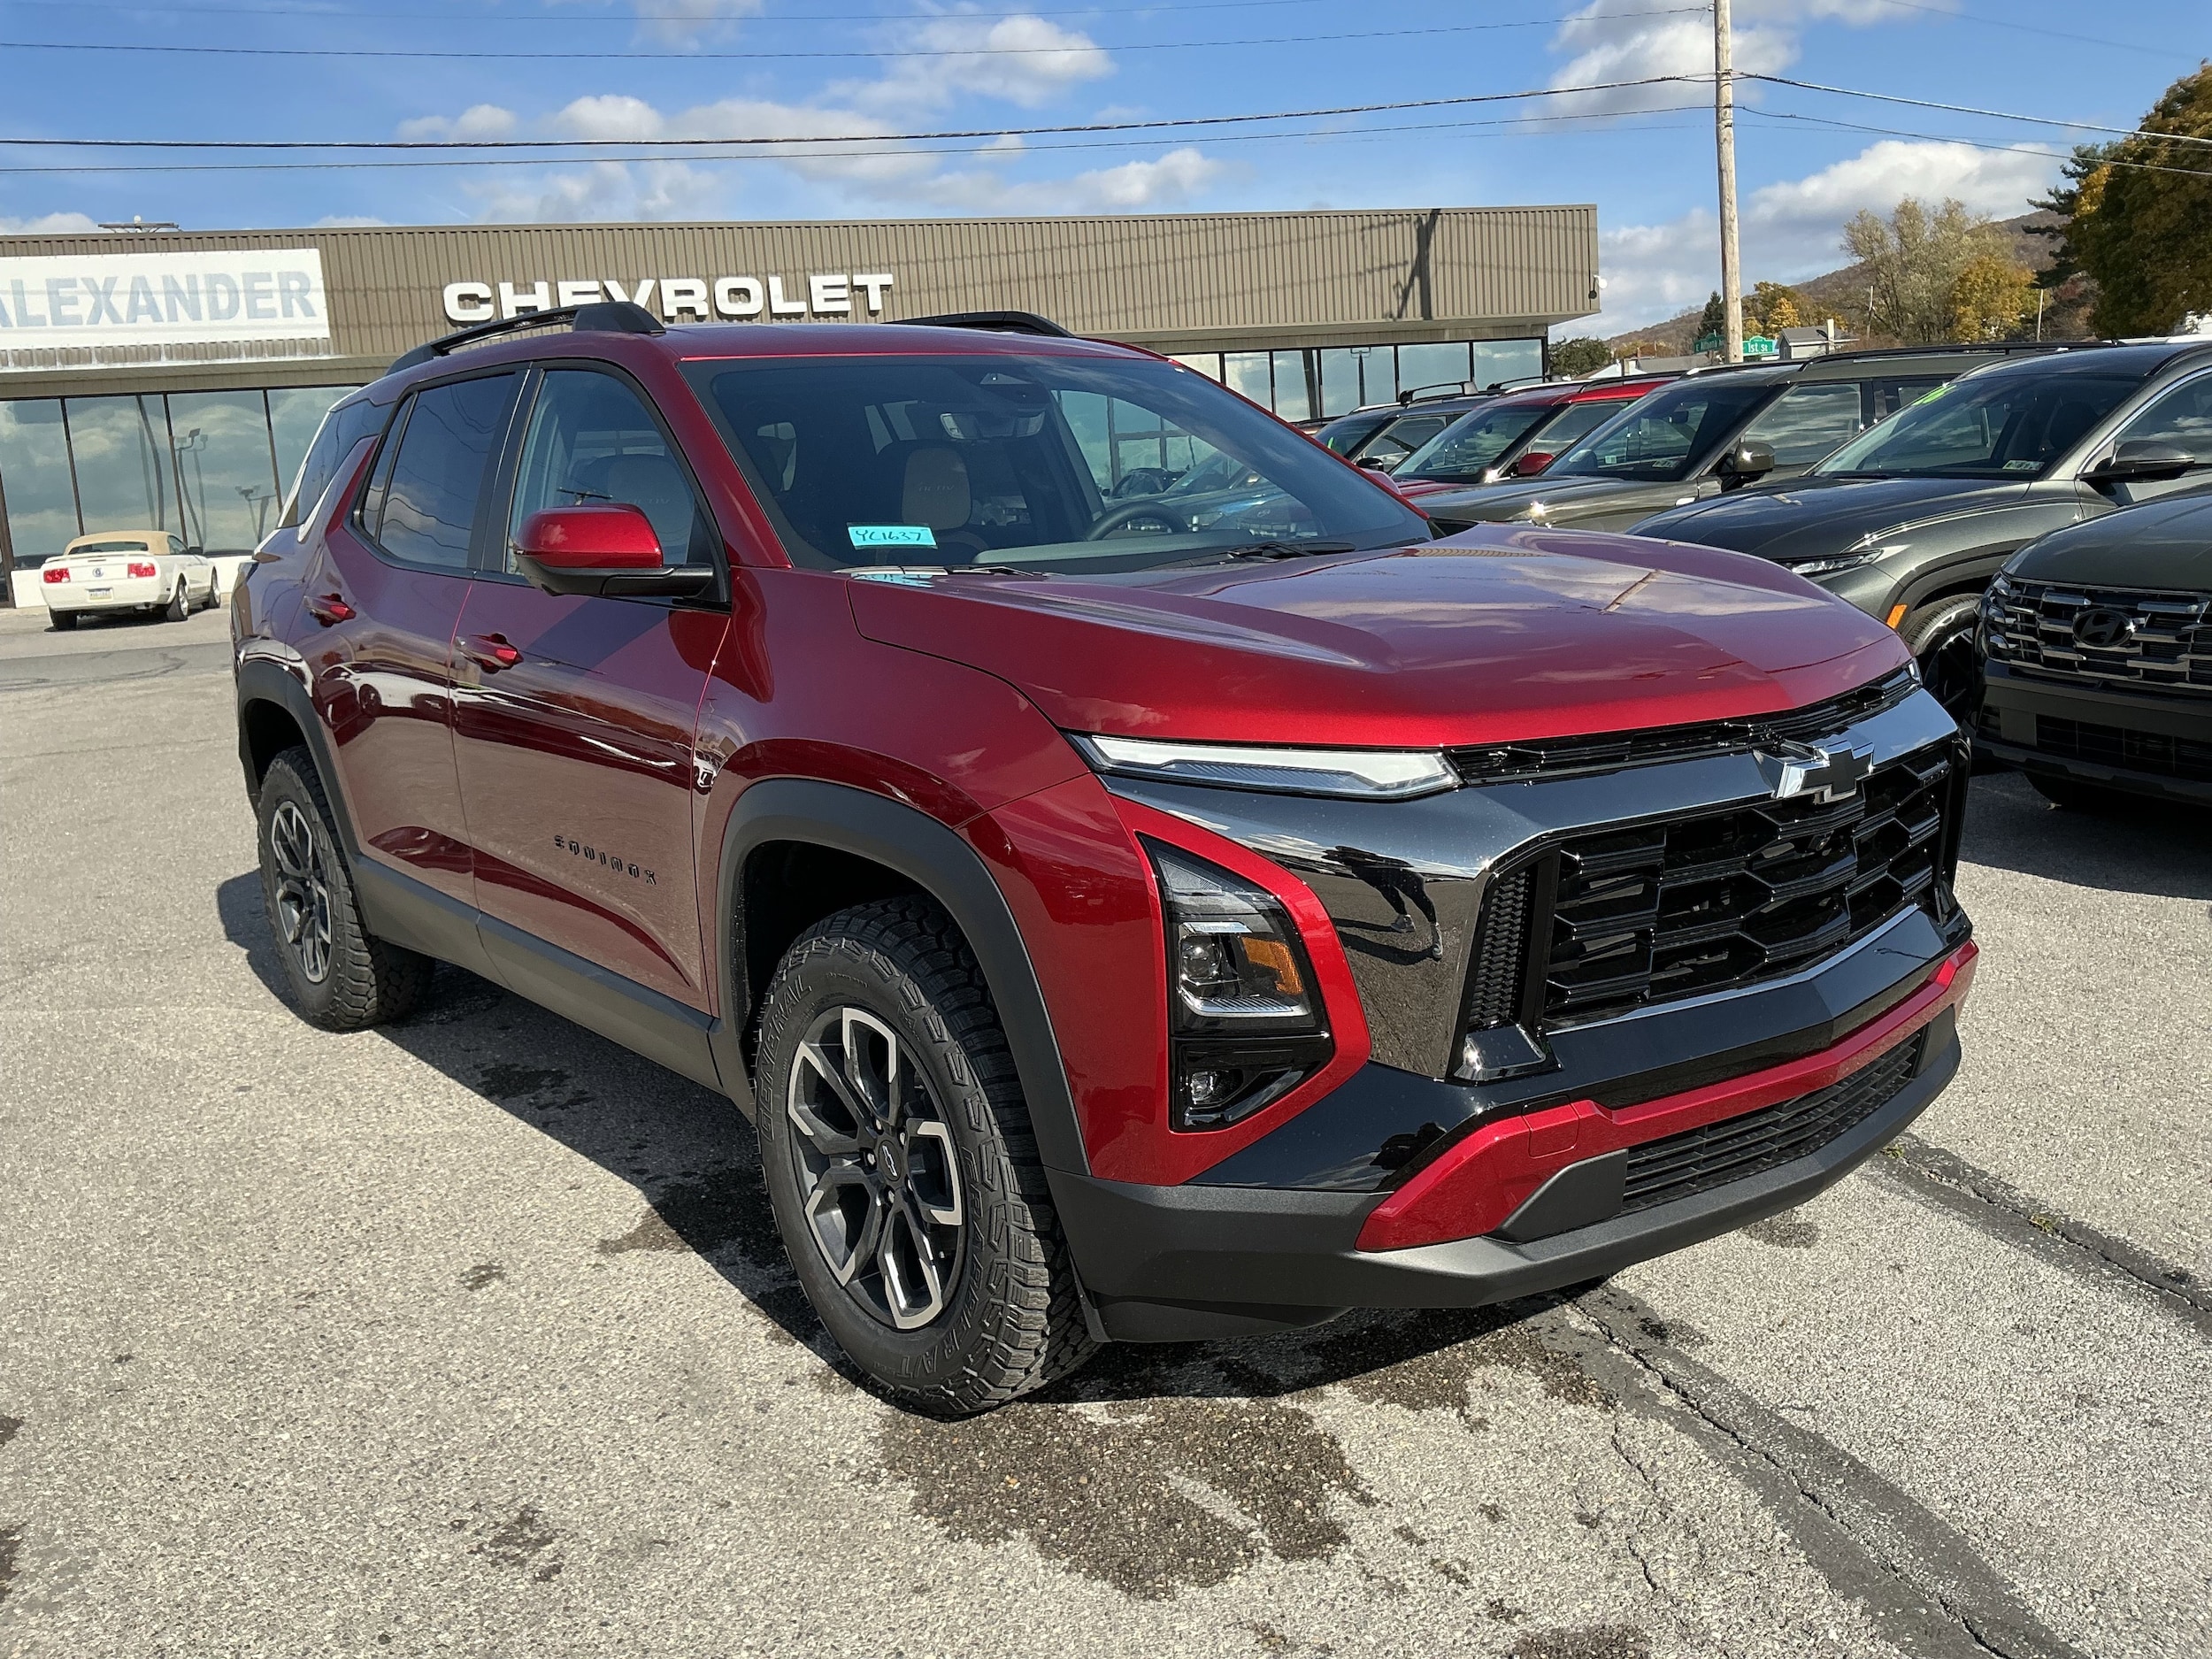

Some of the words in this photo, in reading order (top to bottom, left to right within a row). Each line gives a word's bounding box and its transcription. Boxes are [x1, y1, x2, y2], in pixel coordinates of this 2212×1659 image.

[442, 274, 894, 322] CHEVROLET
[1747, 342, 1759, 353] 1st
[1761, 343, 1768, 353] St
[856, 529, 922, 541] YC1637
[554, 835, 657, 886] EQUINOX
[758, 974, 813, 1141] GENERAL
